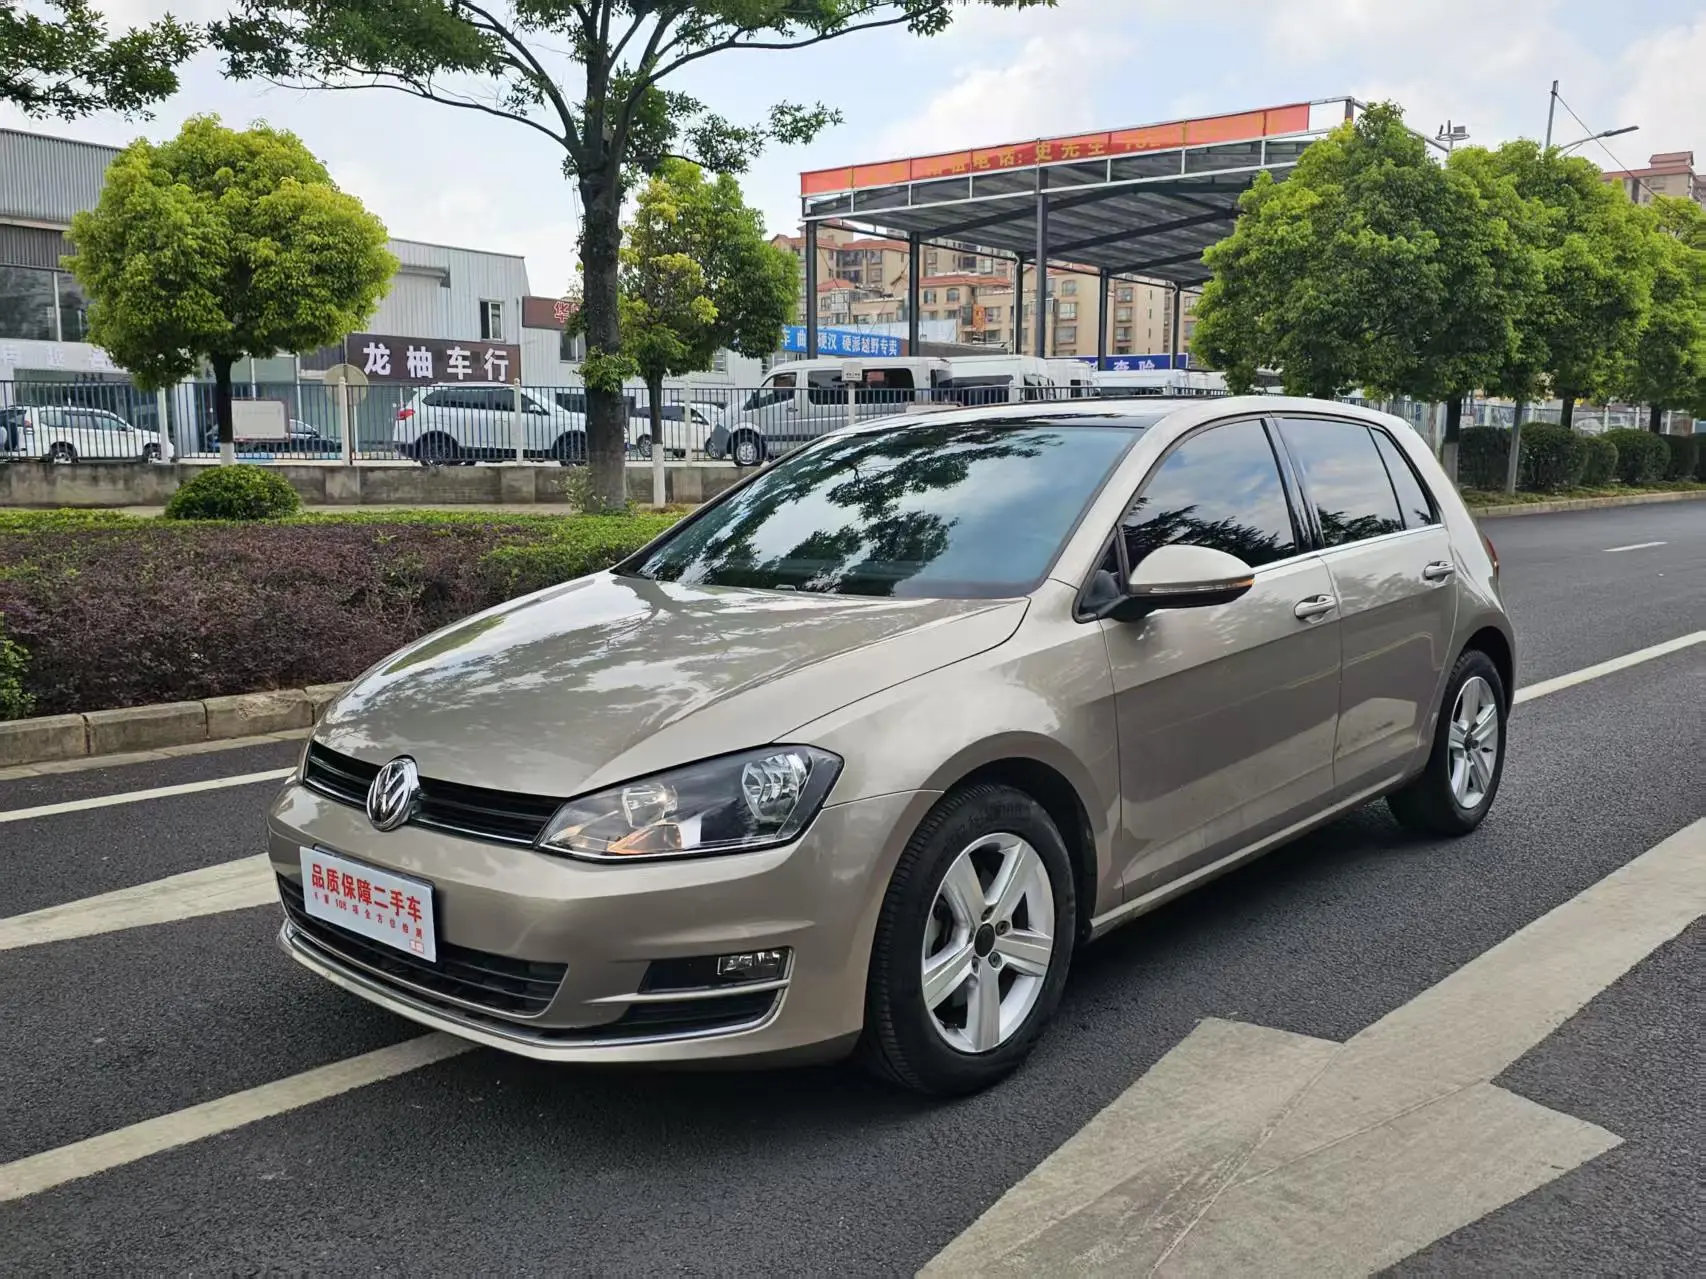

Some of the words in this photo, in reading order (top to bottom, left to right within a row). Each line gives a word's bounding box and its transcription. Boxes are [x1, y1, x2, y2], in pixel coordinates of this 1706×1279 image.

[363, 342, 509, 381] 龙柚车行
[311, 863, 423, 922] 品质保障二手车
